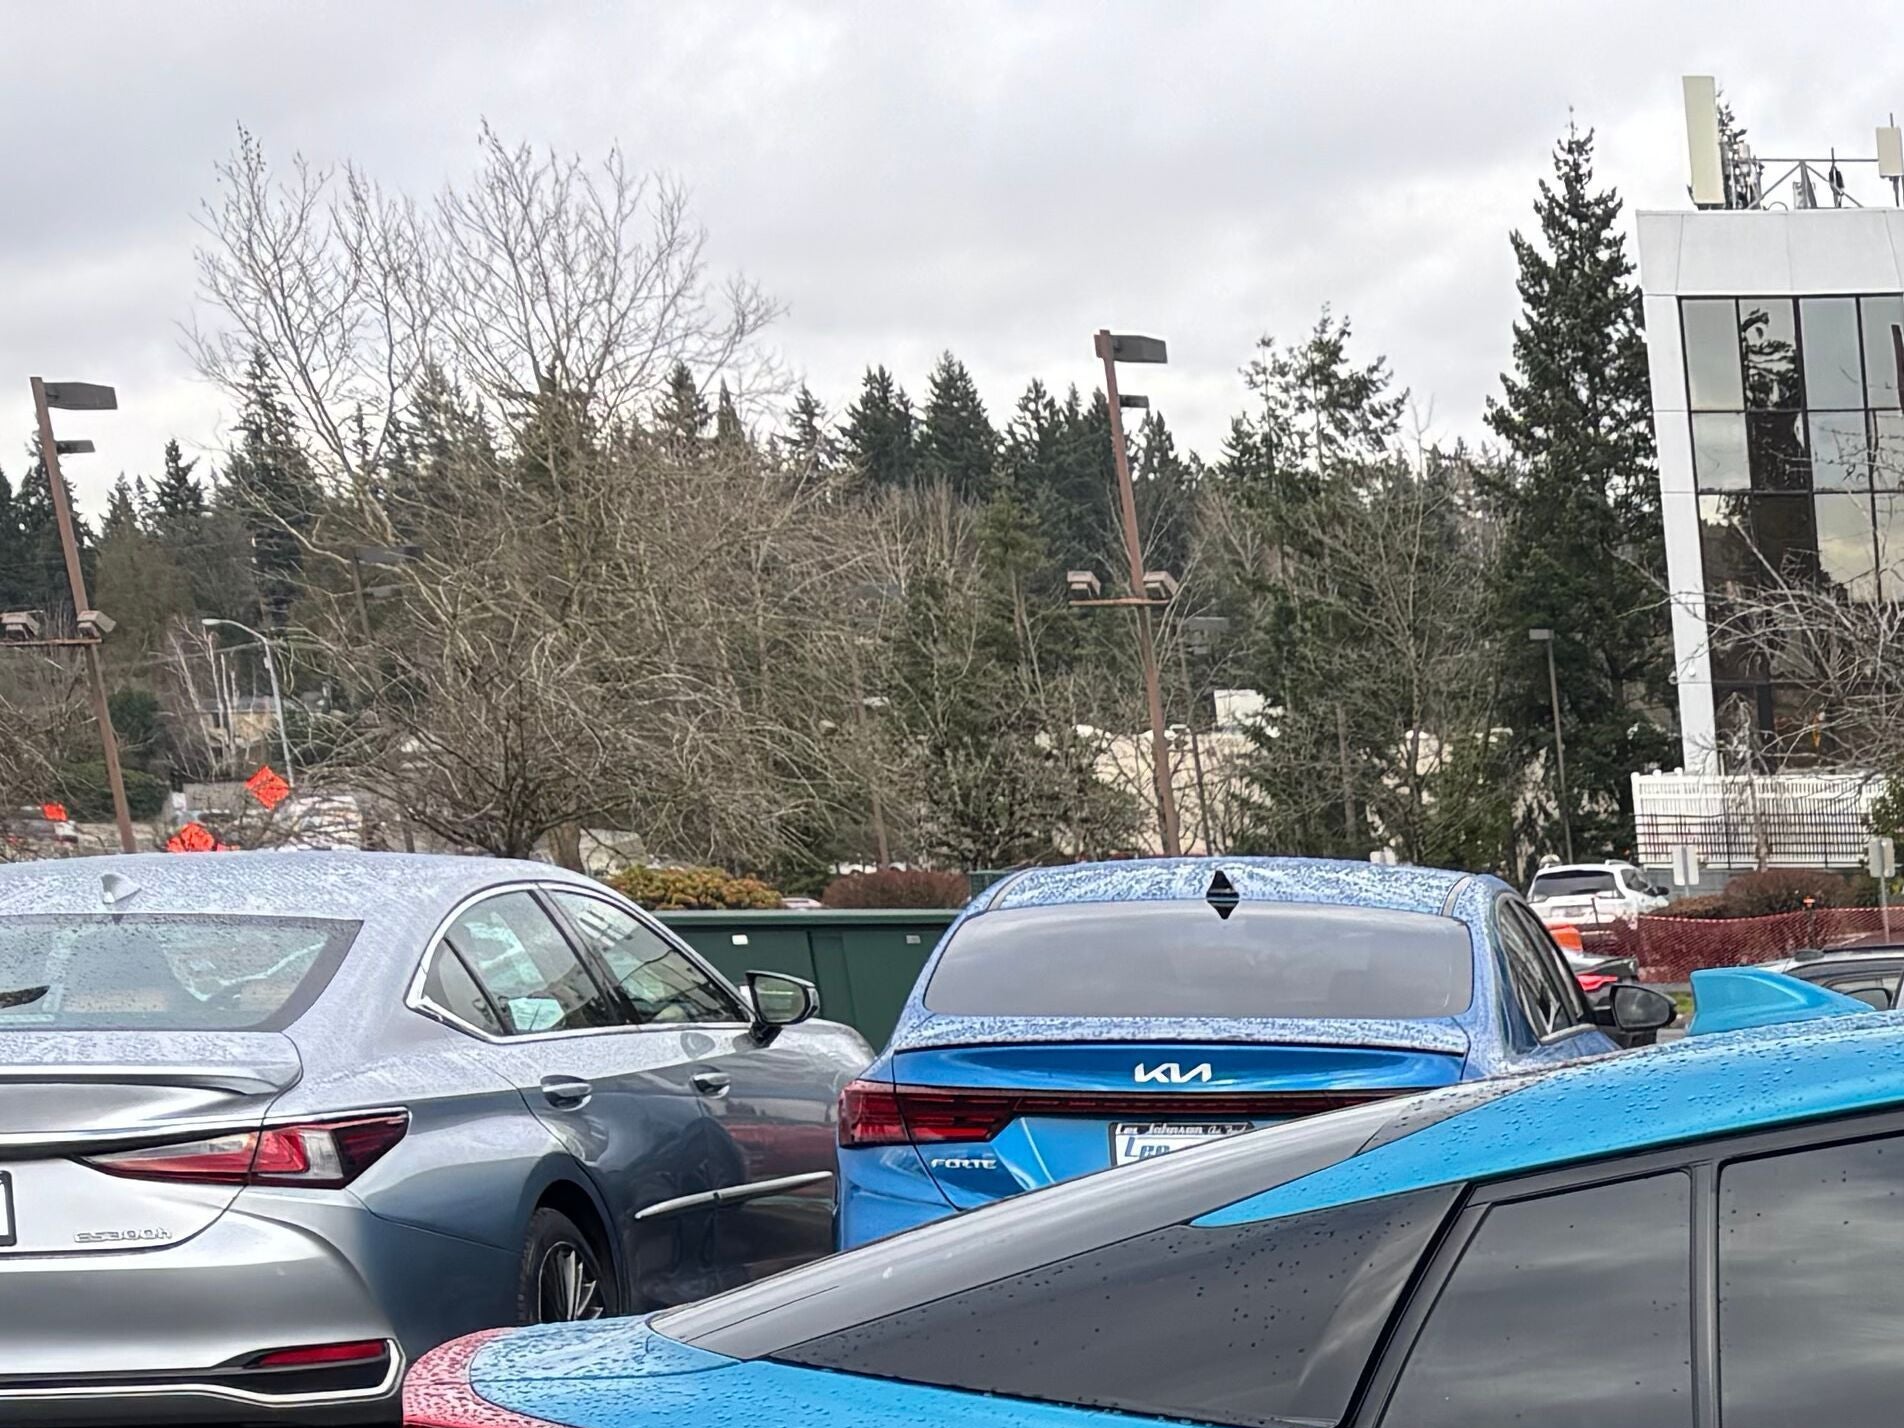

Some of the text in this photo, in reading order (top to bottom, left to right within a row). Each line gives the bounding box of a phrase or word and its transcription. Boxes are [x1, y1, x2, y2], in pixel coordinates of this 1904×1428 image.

[1134, 1062, 1212, 1083] KIA
[931, 1159, 997, 1169] FORTE
[73, 1228, 173, 1243] ES300h
